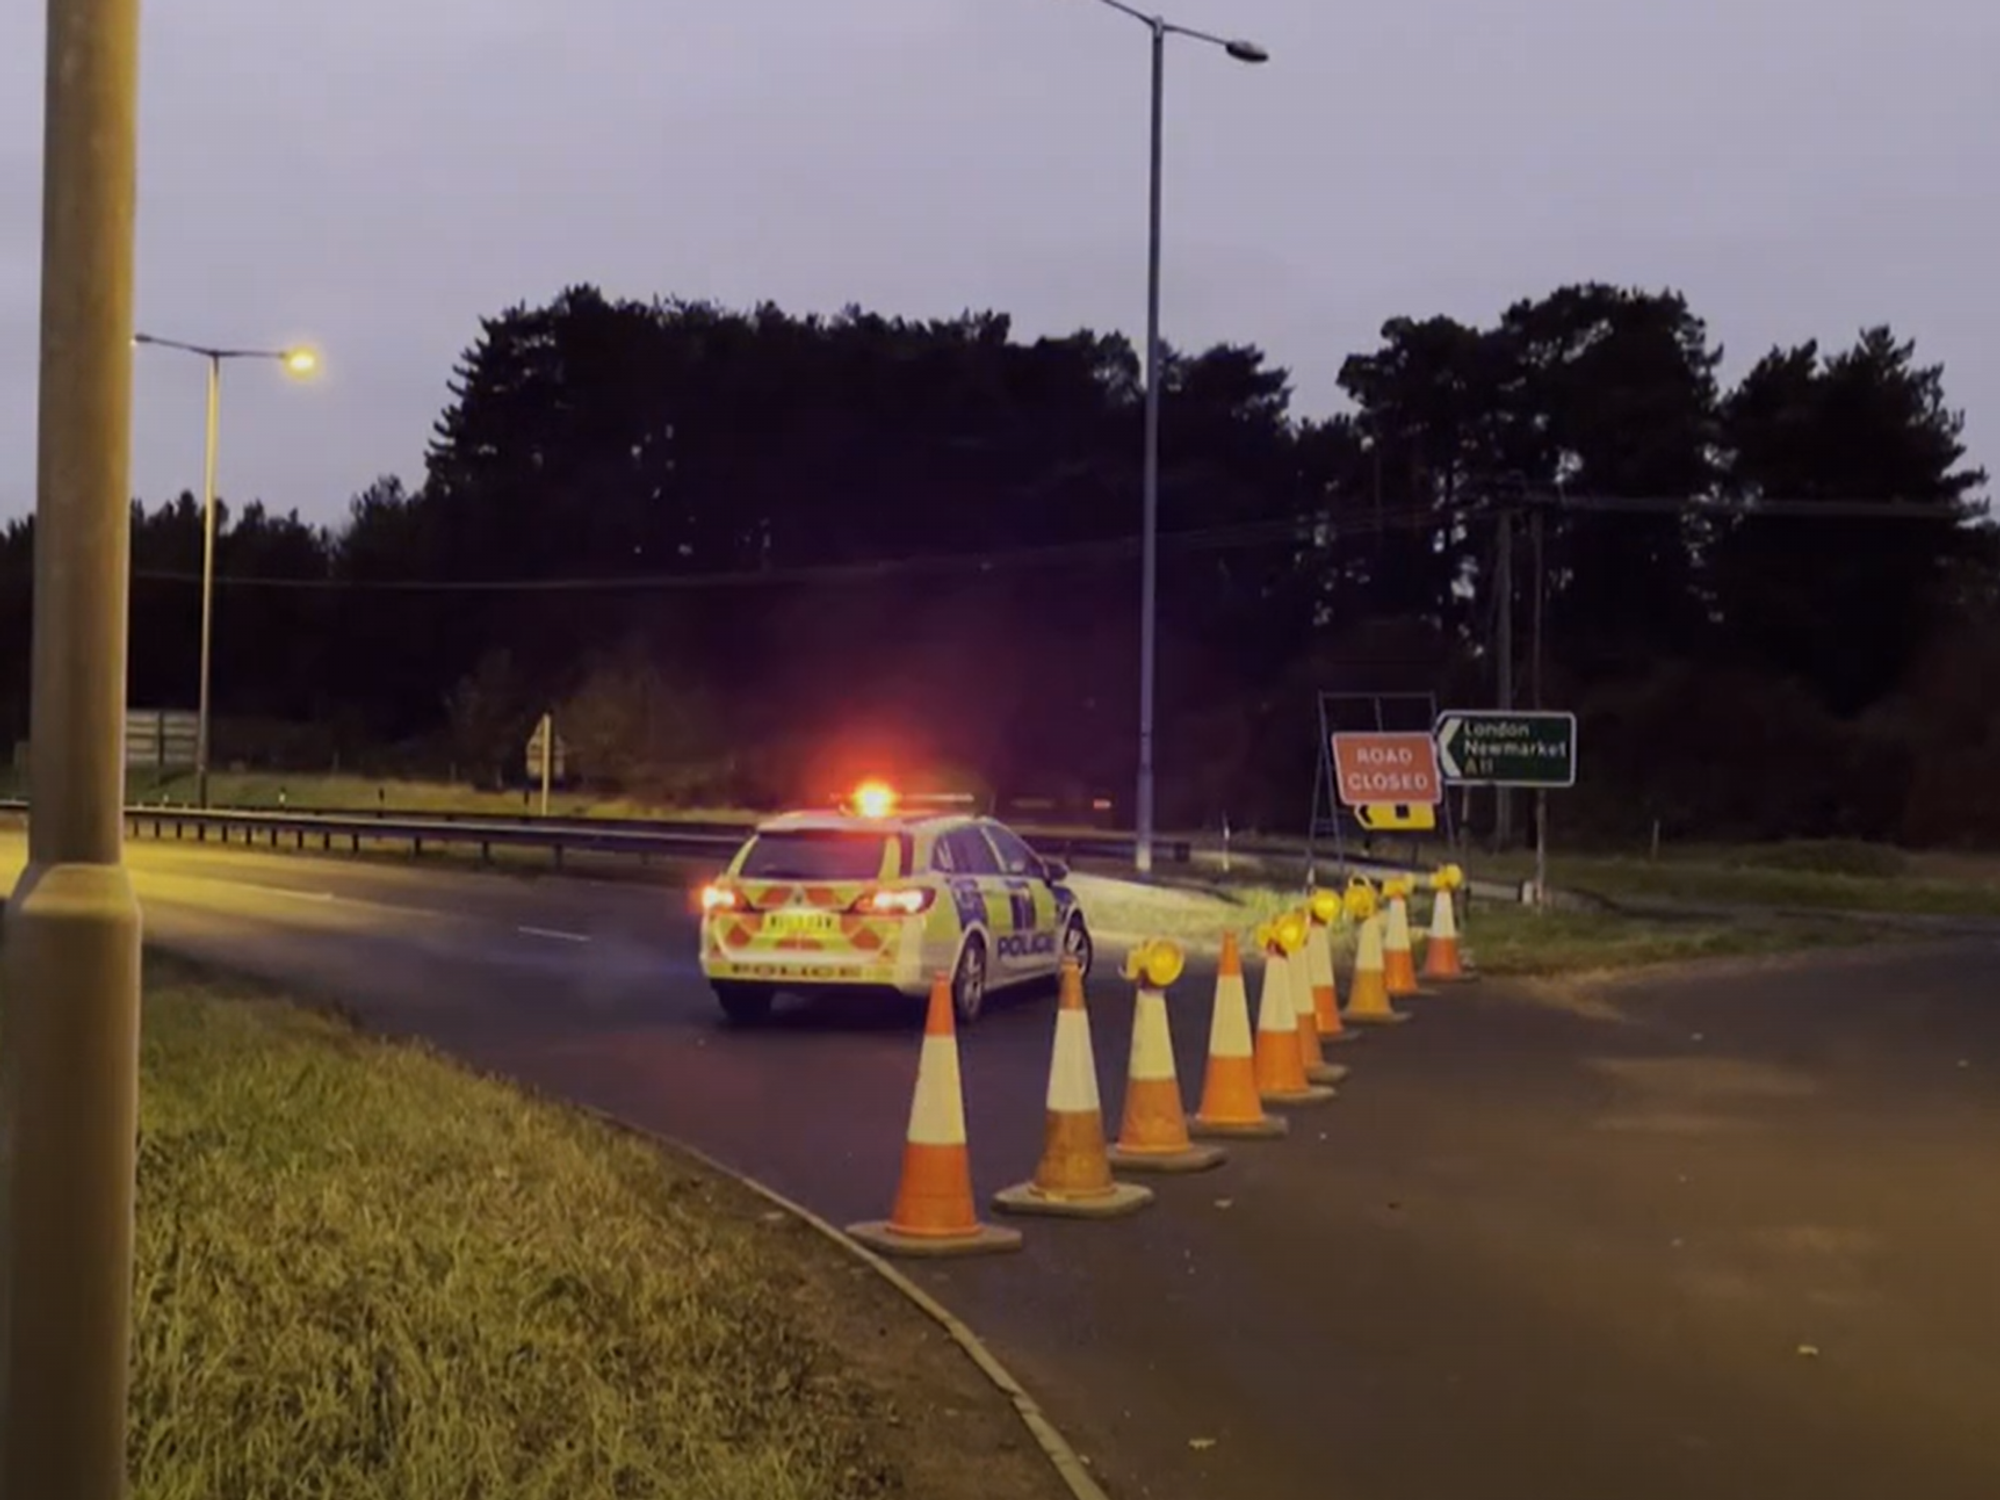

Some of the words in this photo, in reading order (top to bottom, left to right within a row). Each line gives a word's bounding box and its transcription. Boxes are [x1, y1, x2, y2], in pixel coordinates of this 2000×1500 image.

[1464, 720, 1530, 738] London
[1357, 747, 1413, 764] ROAD
[1464, 739, 1567, 758] Newmarket
[1348, 773, 1428, 791] CLOSED
[997, 930, 1056, 958] POLICE
